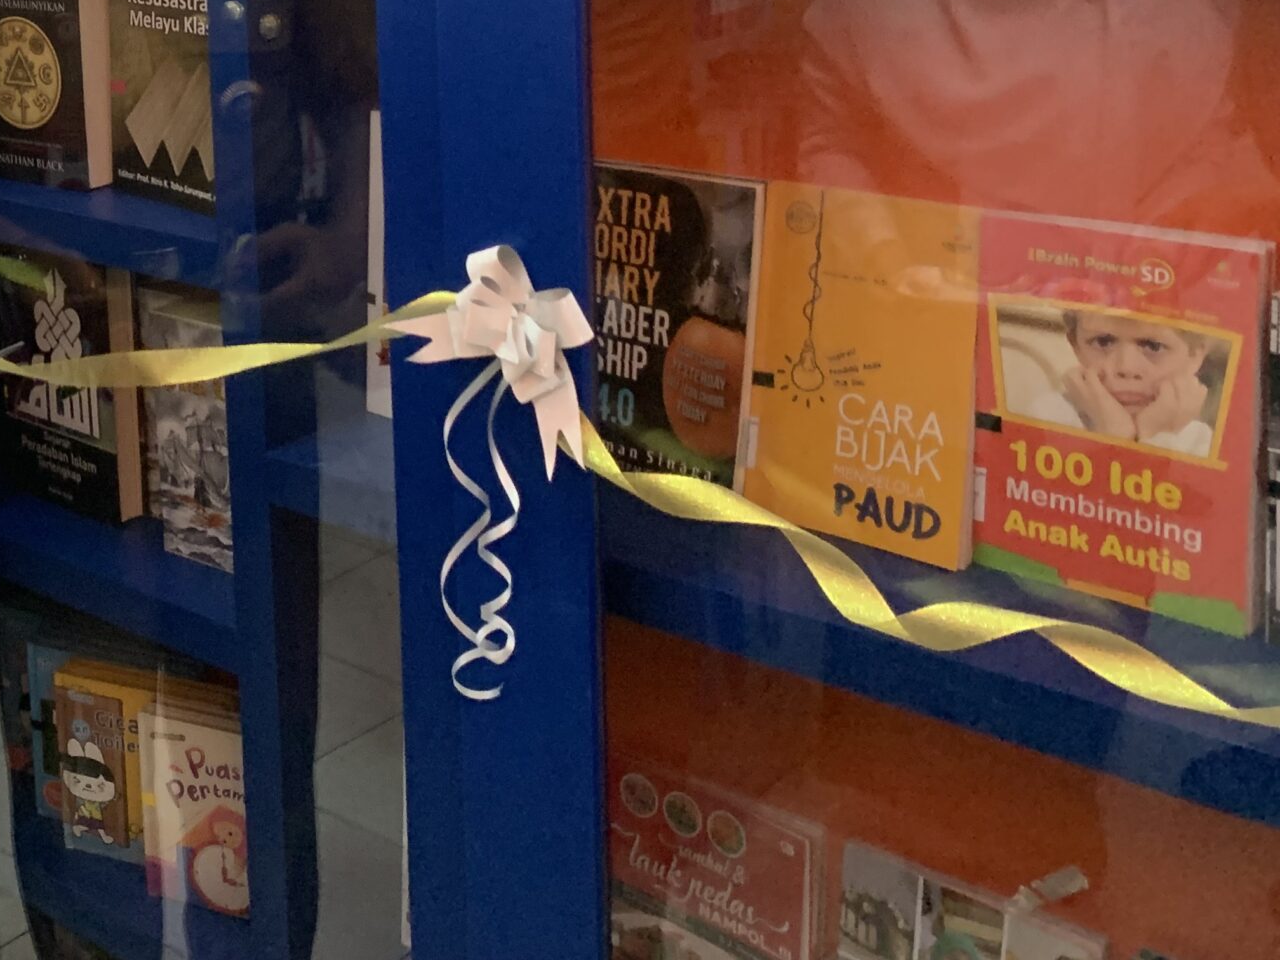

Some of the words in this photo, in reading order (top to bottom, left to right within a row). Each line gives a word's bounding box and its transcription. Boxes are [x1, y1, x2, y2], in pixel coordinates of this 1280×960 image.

[130, 9, 180, 35] Melayu
[36, 158, 65, 173] BLACK
[596, 185, 672, 233] XTRA
[595, 222, 656, 268] ORDI
[1085, 255, 1138, 277] Power
[1140, 265, 1170, 286] SD
[597, 297, 670, 348] ADER
[838, 392, 945, 447] CARA
[71, 452, 97, 474] Islam
[835, 424, 942, 483] BIJAK
[1009, 440, 1093, 487] 100
[1110, 460, 1183, 511] Ide
[833, 482, 942, 541] PAUD
[1006, 476, 1203, 553] Membimbing
[1004, 509, 1089, 553] Anak
[1099, 533, 1191, 581] Autis
[93, 732, 140, 753] Toile
[185, 747, 241, 780] Puas
